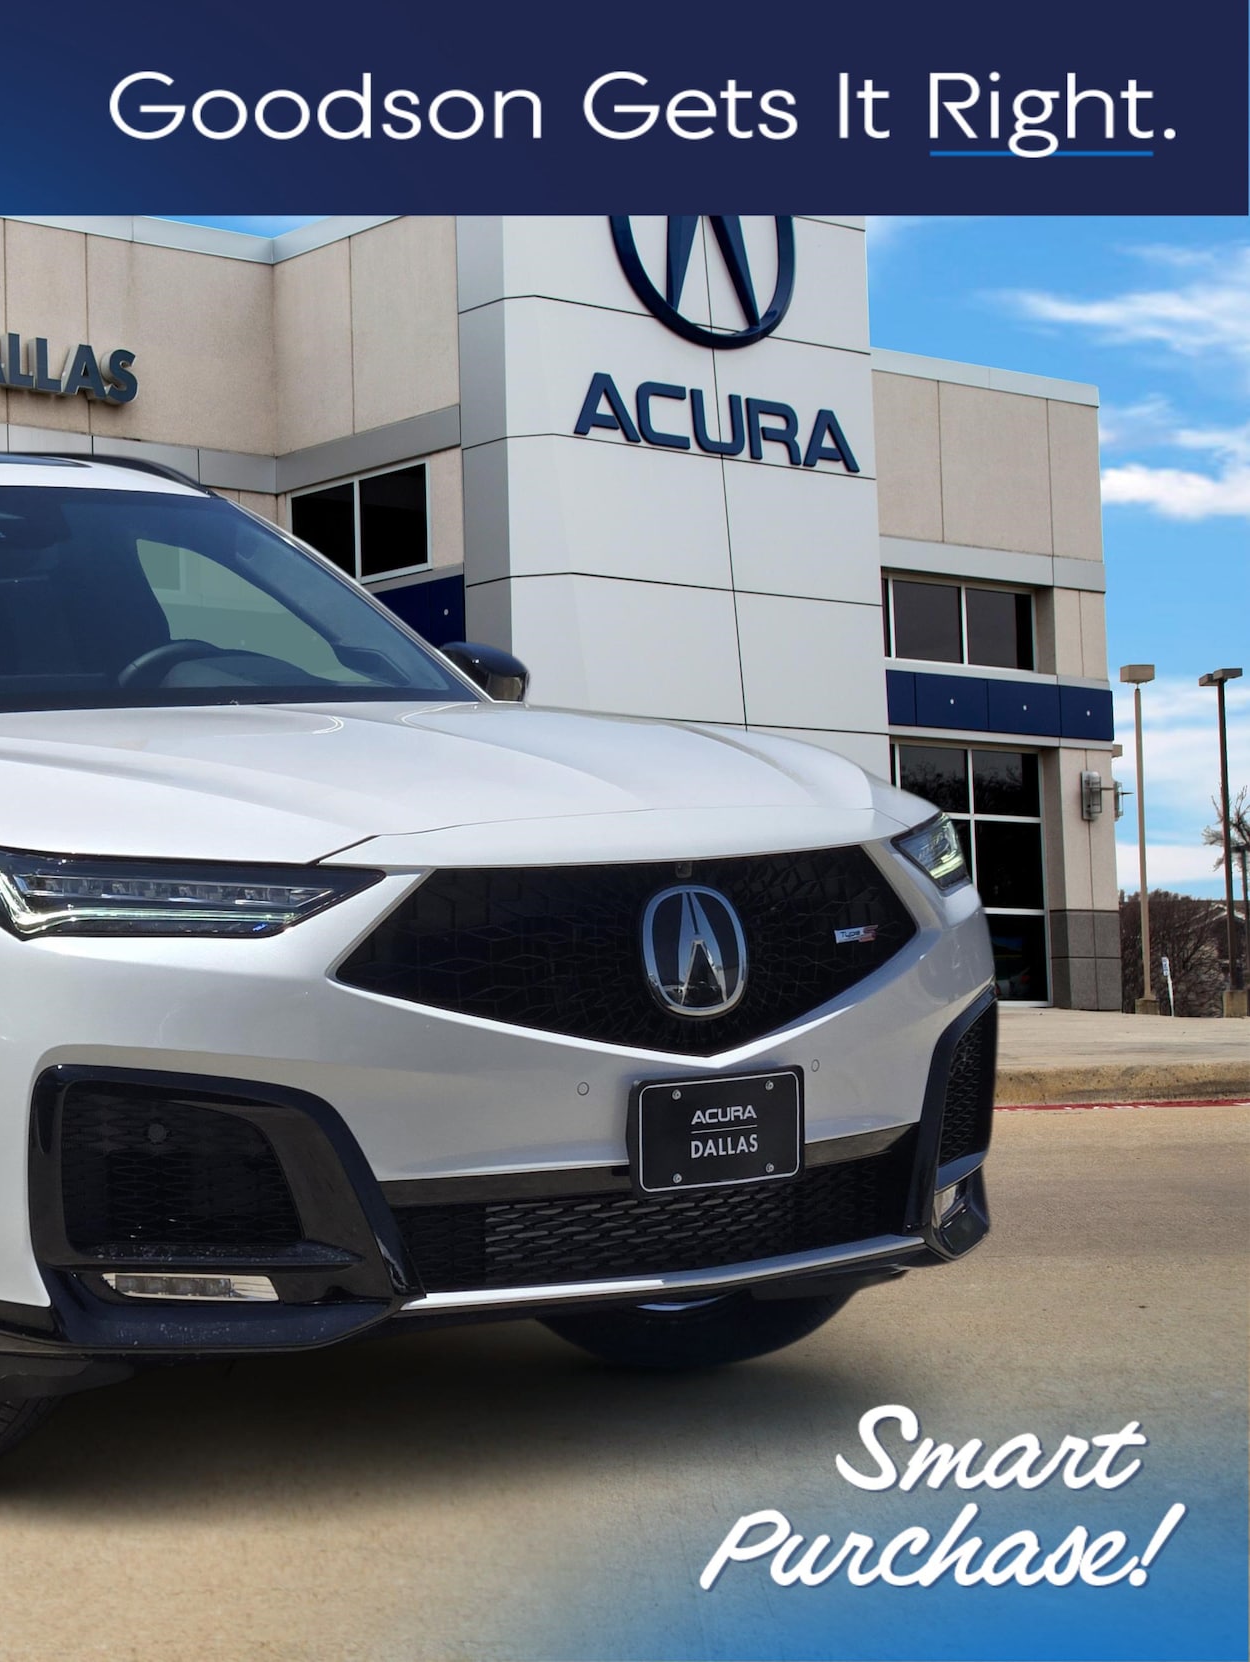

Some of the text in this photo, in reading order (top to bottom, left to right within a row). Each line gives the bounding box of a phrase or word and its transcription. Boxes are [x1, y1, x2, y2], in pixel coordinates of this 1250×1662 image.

[573, 371, 861, 474] ACURA
[691, 1105, 757, 1125] ACURA
[690, 1134, 759, 1159] DALLAS
